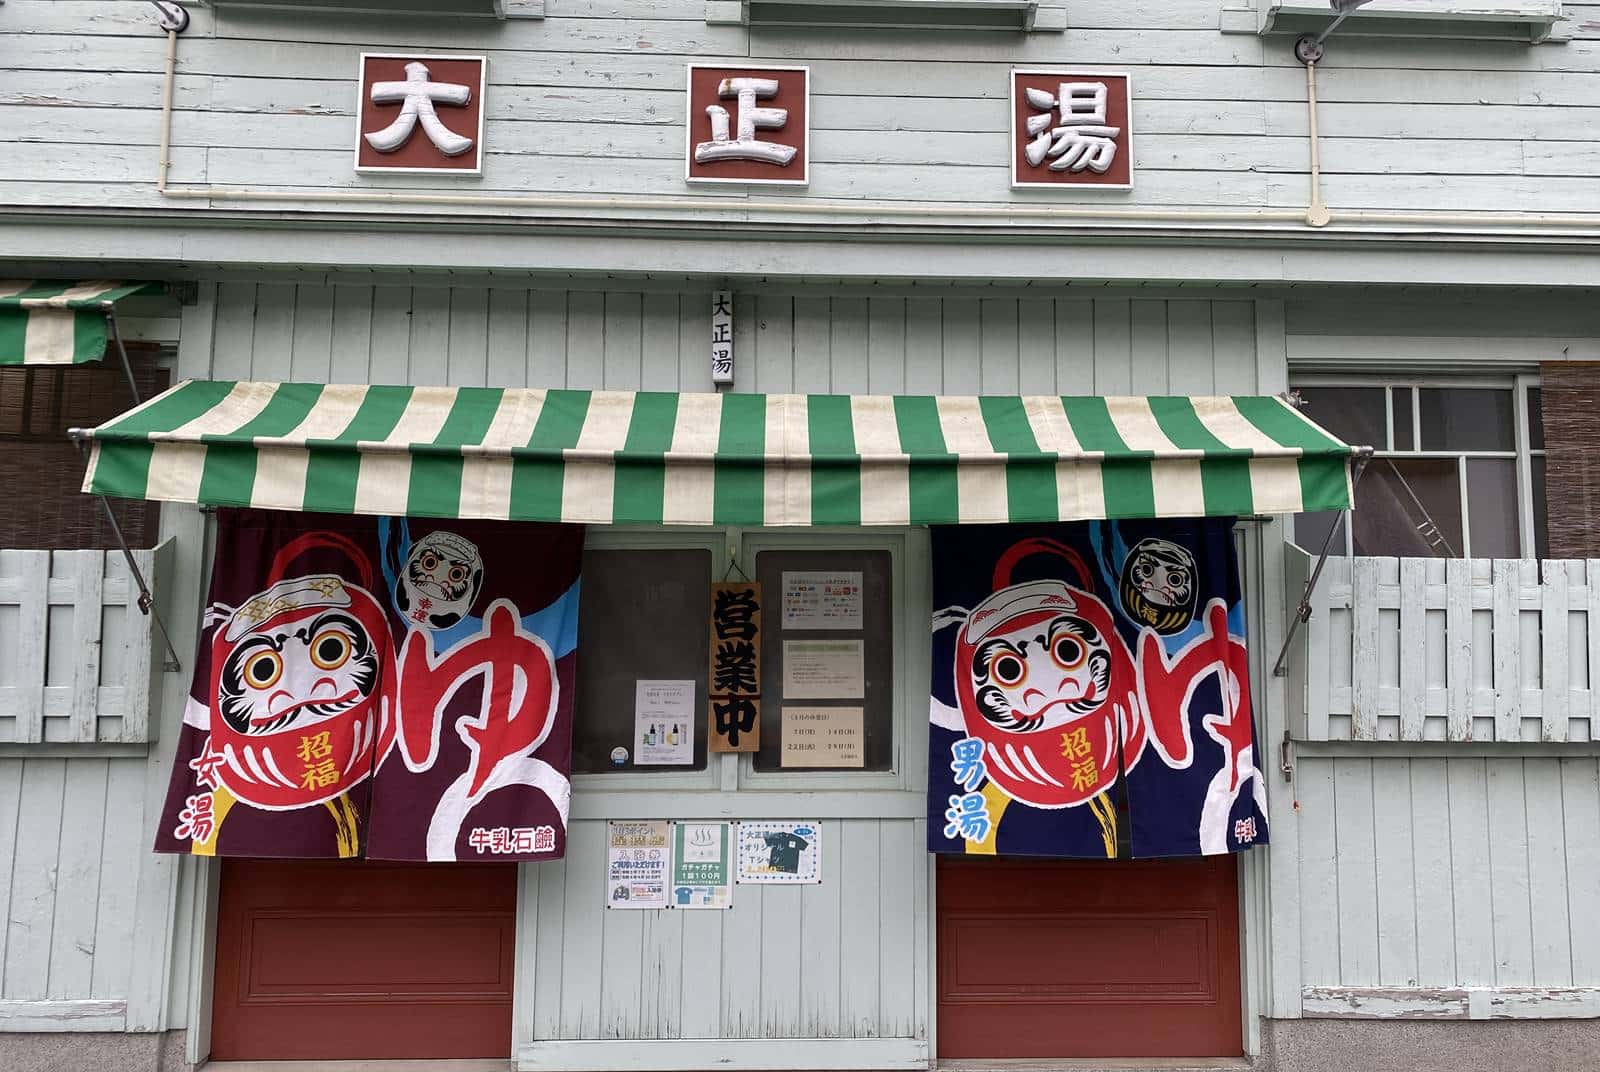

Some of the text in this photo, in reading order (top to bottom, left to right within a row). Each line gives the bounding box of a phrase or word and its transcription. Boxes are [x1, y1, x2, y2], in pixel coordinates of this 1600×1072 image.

[711, 294, 731, 374] 大正湯
[399, 602, 556, 799] ゆ
[712, 588, 760, 747] 営業中
[174, 736, 226, 844] 女湯
[296, 730, 340, 792] 招福
[944, 737, 992, 843] 男湯
[1059, 727, 1099, 793] 招福
